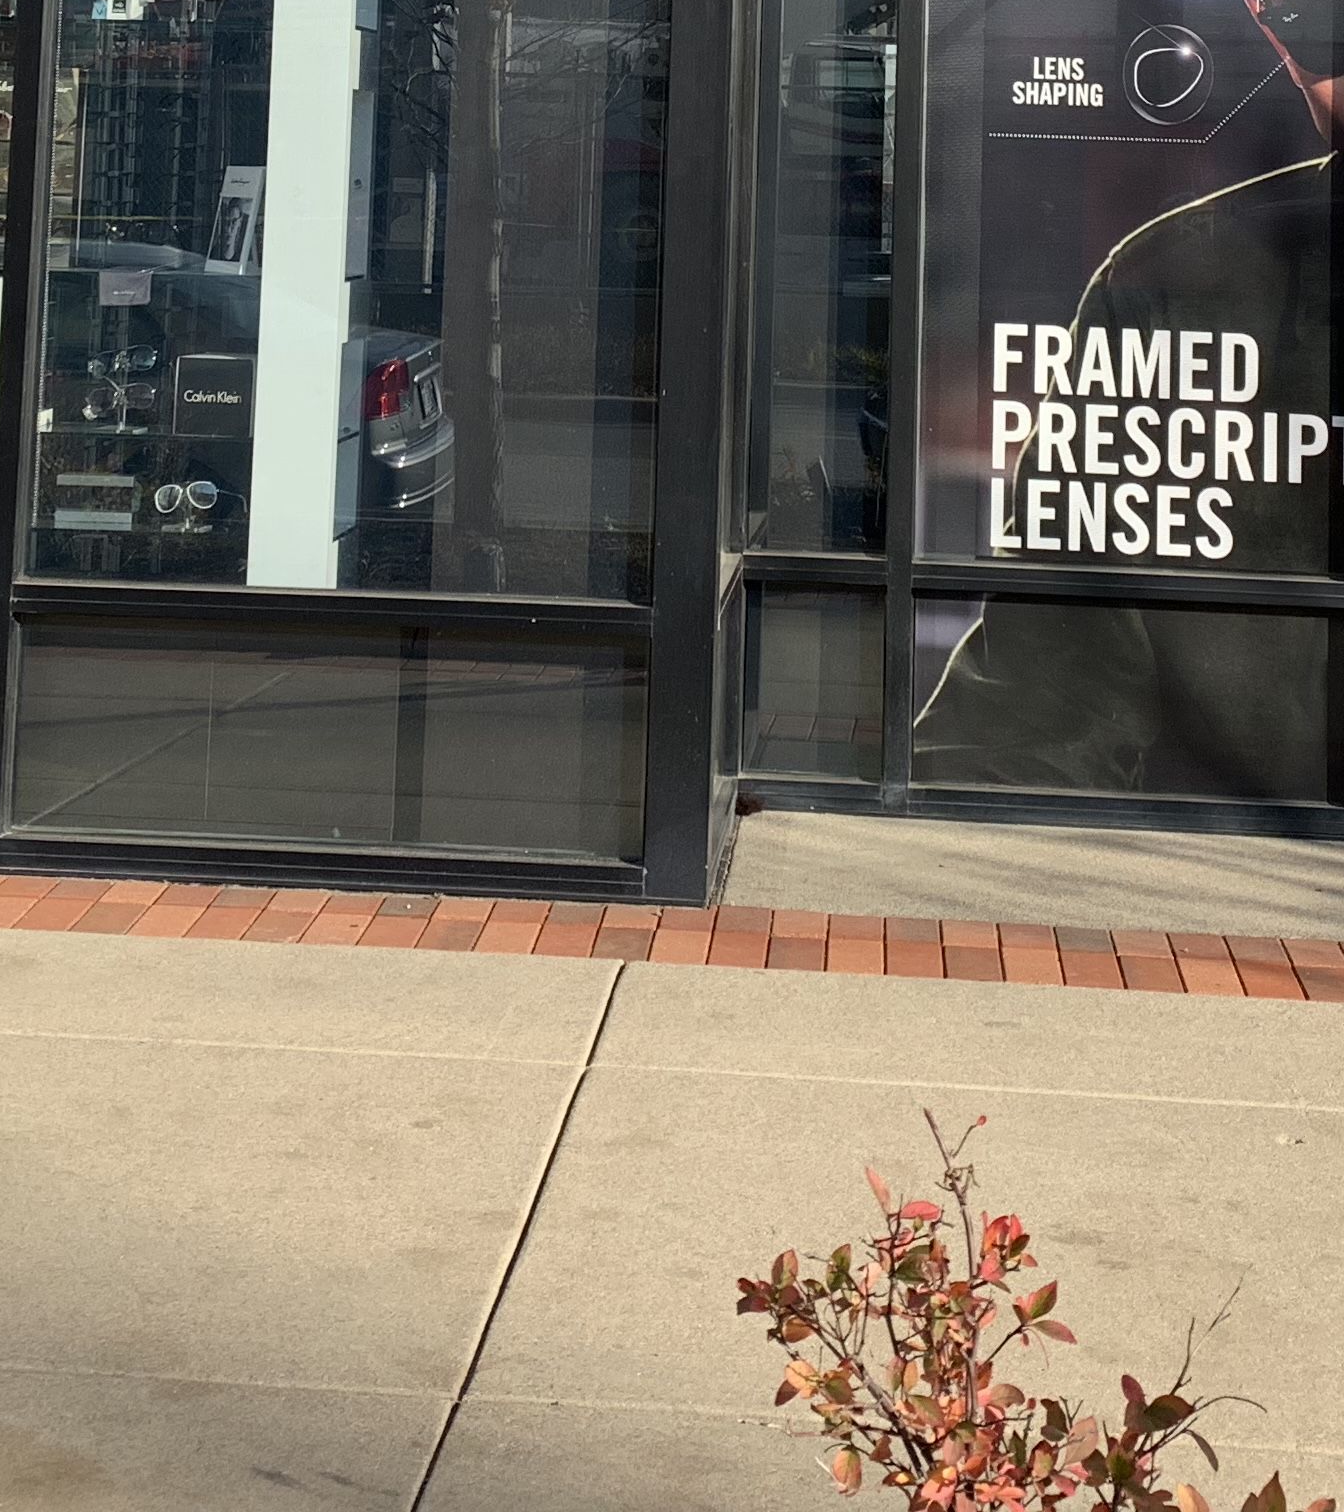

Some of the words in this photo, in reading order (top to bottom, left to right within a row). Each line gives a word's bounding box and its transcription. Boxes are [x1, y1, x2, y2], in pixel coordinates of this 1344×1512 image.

[1033, 56, 1085, 81] LENS
[1012, 81, 1104, 107] SHAPING
[992, 322, 1260, 404] FRAMED
[183, 389, 216, 403] Calvin
[217, 391, 243, 404] Klein
[989, 477, 1235, 561] LENSES
